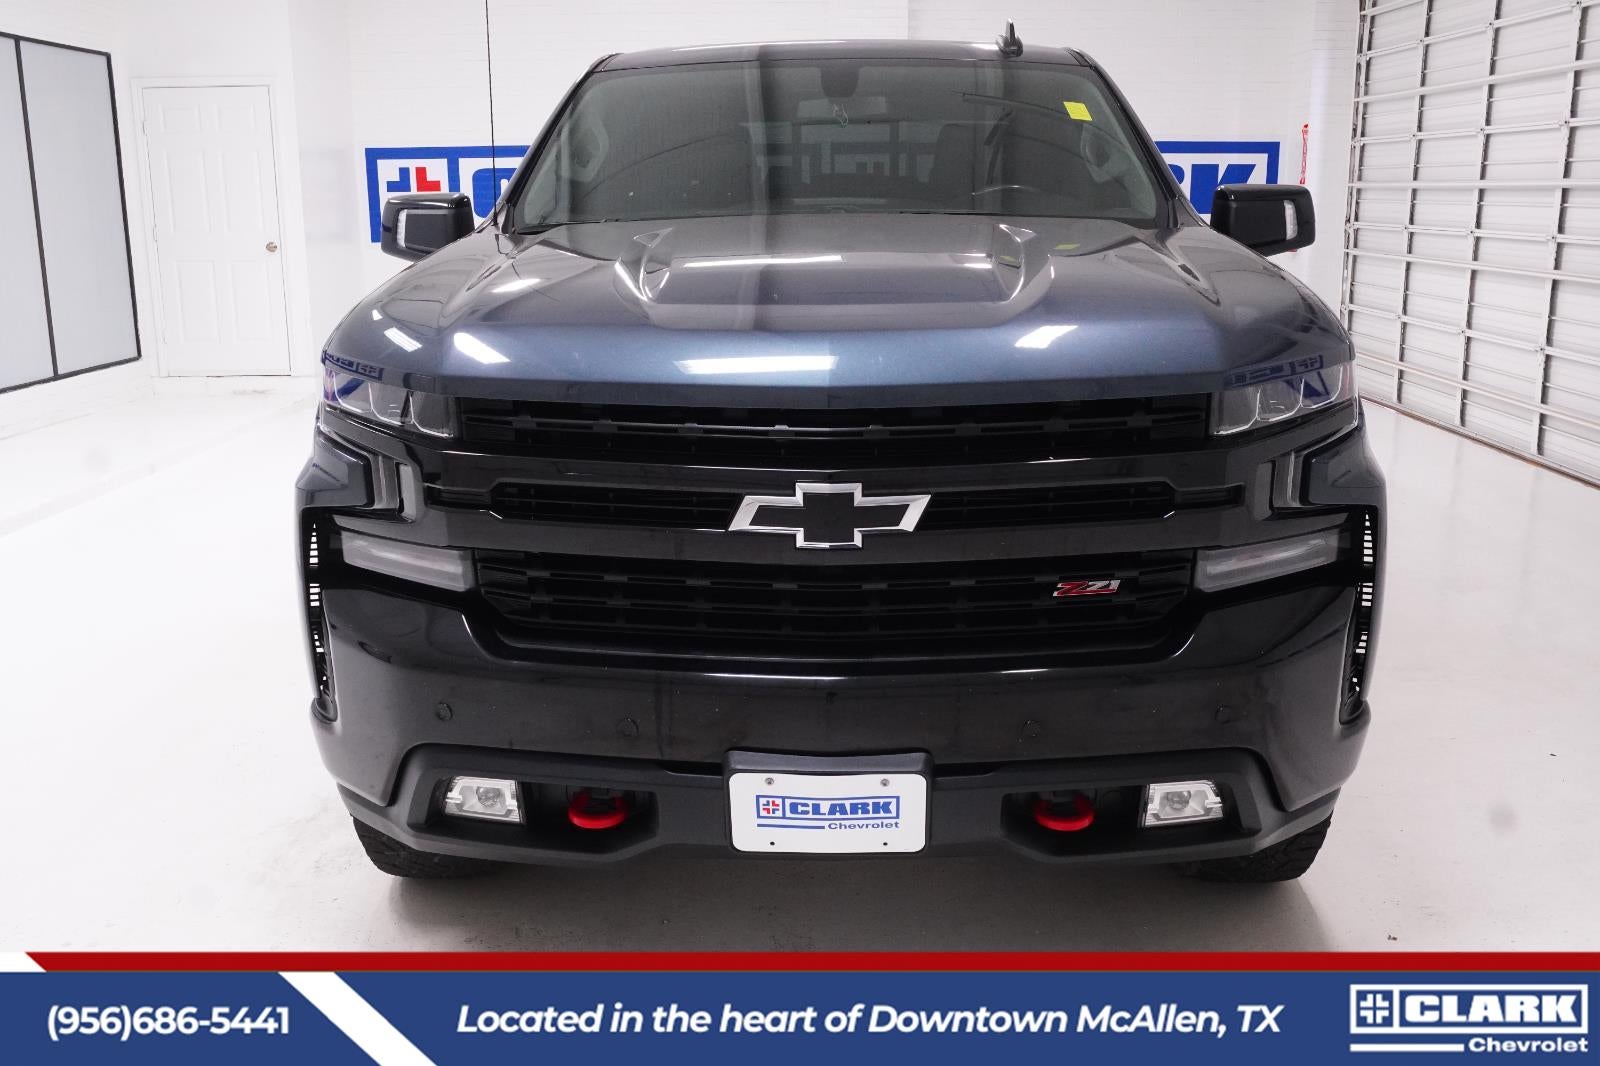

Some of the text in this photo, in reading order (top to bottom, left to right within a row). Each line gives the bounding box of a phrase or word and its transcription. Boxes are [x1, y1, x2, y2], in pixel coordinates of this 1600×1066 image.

[1053, 580, 1120, 596] Z71
[789, 801, 892, 816] CLARK
[828, 821, 900, 830] Chevrolet
